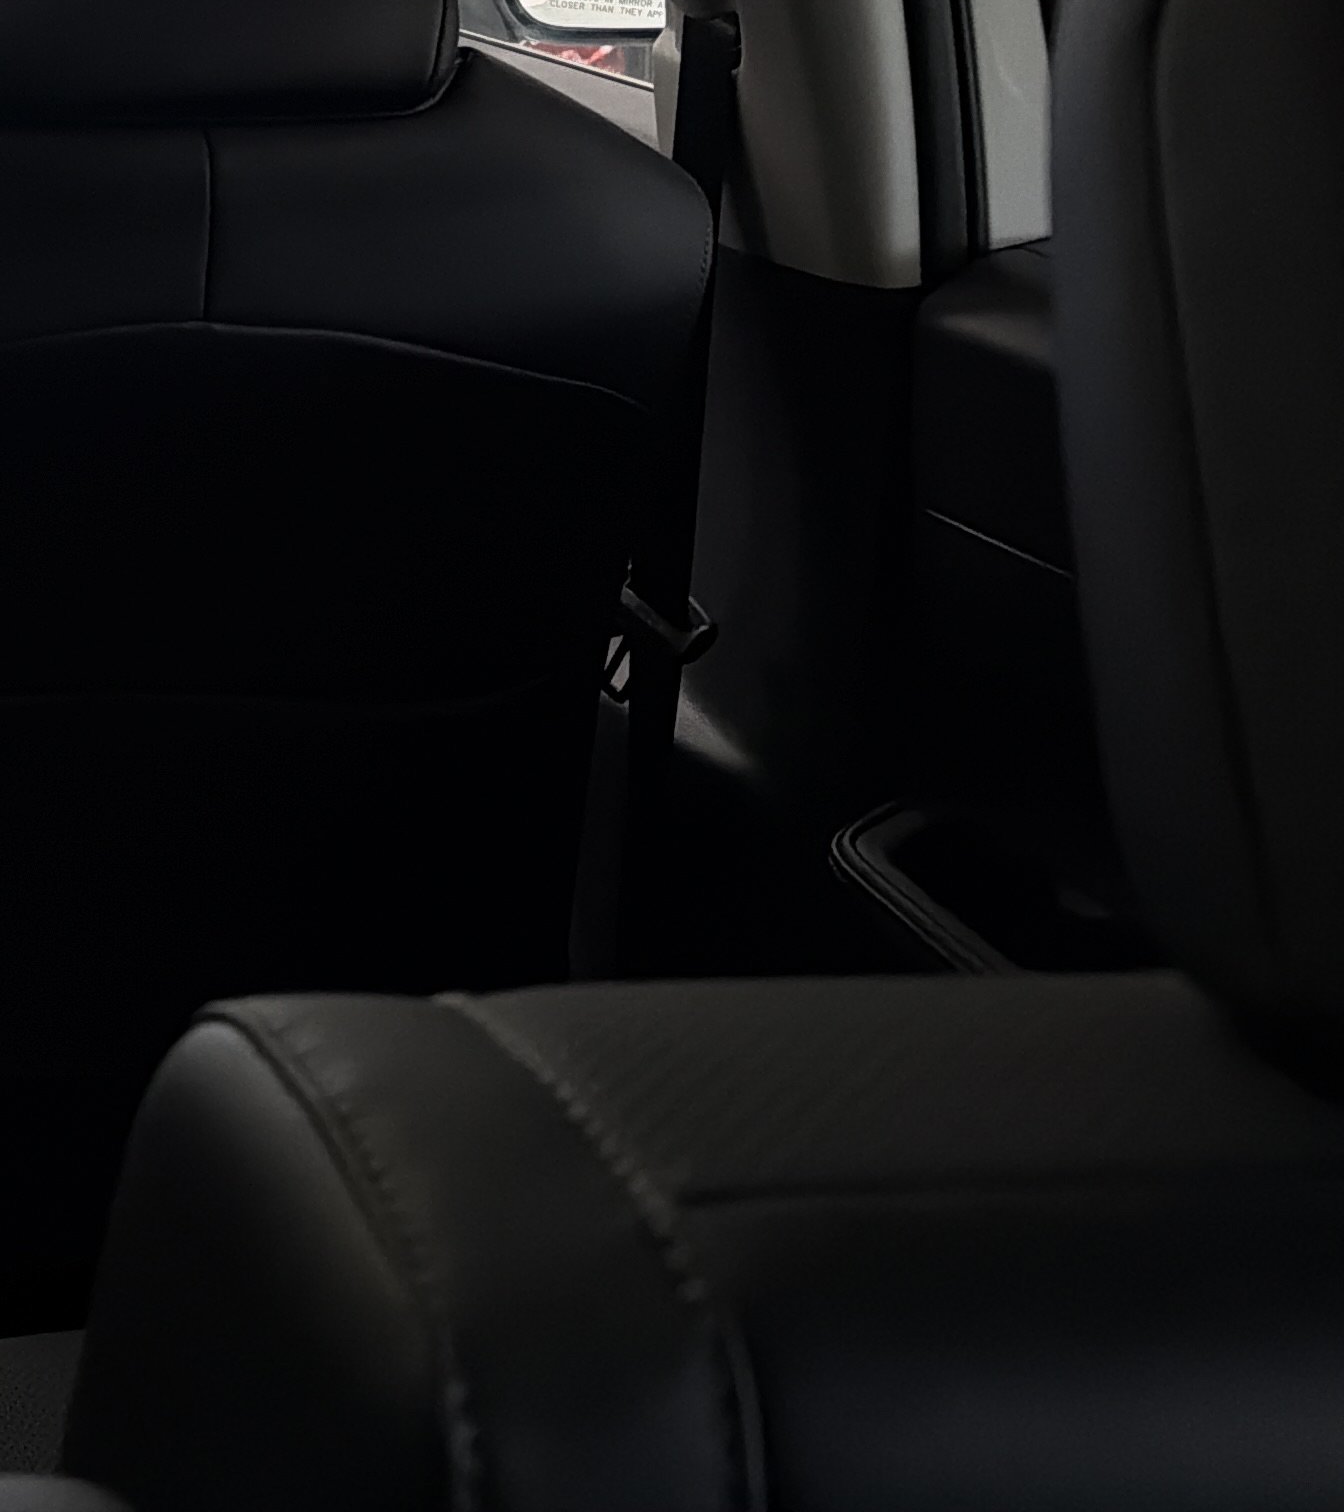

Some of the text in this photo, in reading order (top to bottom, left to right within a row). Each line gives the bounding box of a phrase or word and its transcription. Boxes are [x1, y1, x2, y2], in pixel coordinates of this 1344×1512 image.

[550, 0, 585, 10] CLOSER
[591, 3, 614, 14] THAN
[620, 7, 643, 17] THEY
